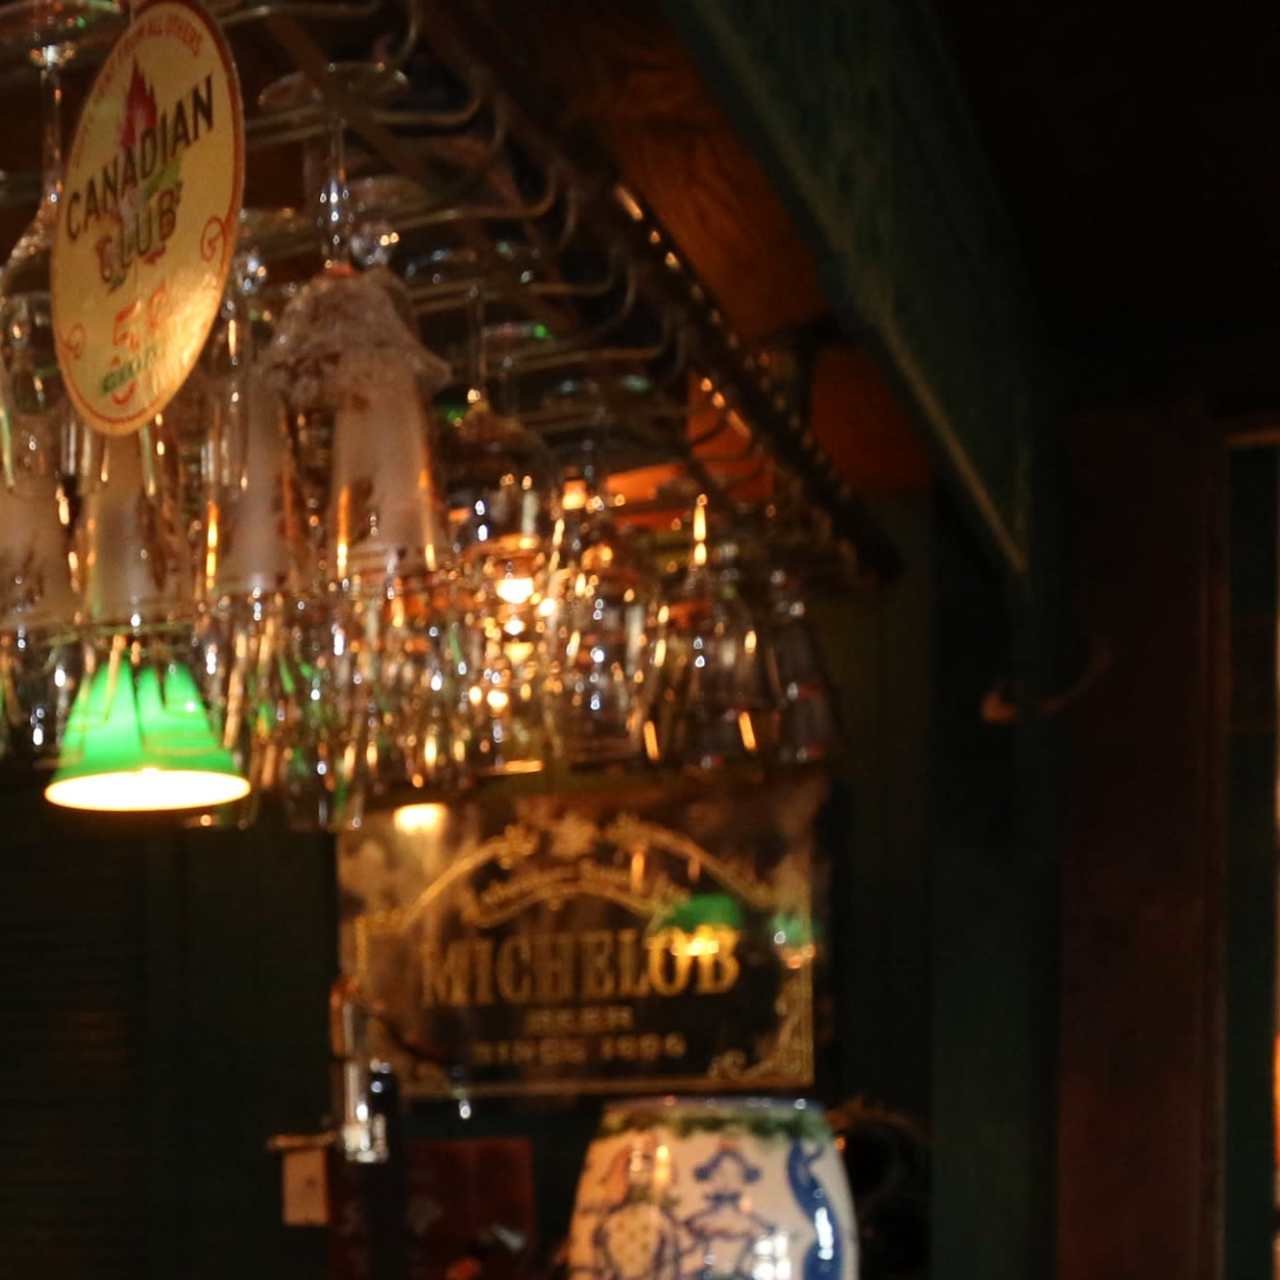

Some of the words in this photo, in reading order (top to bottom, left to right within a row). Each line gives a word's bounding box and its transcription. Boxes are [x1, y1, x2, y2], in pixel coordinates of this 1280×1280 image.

[66, 73, 215, 242] CANADIAN
[95, 178, 183, 284] CLUB
[420, 925, 740, 1008] MICHELOB
